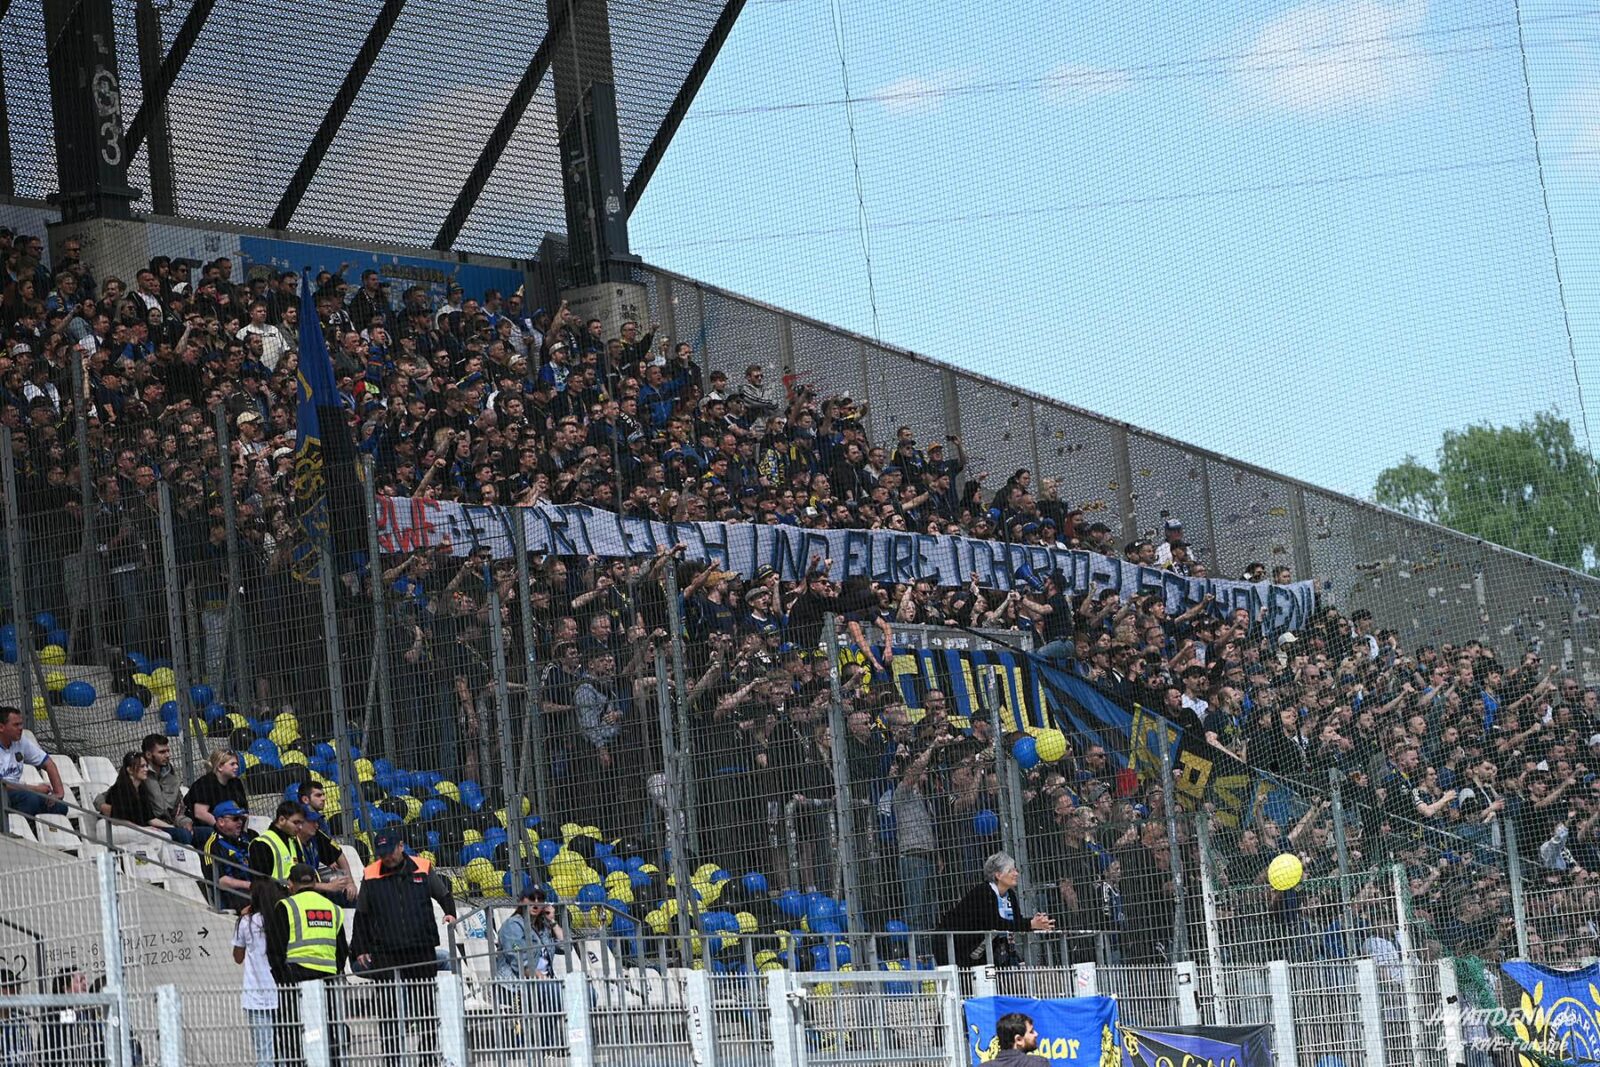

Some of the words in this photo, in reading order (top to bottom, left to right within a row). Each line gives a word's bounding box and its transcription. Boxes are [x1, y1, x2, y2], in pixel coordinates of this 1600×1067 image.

[843, 530, 941, 584] EURE
[123, 934, 157, 951] PLATZ
[161, 930, 184, 945] 1-32
[161, 947, 192, 964] 20-32
[1026, 1037, 1081, 1061] aar
